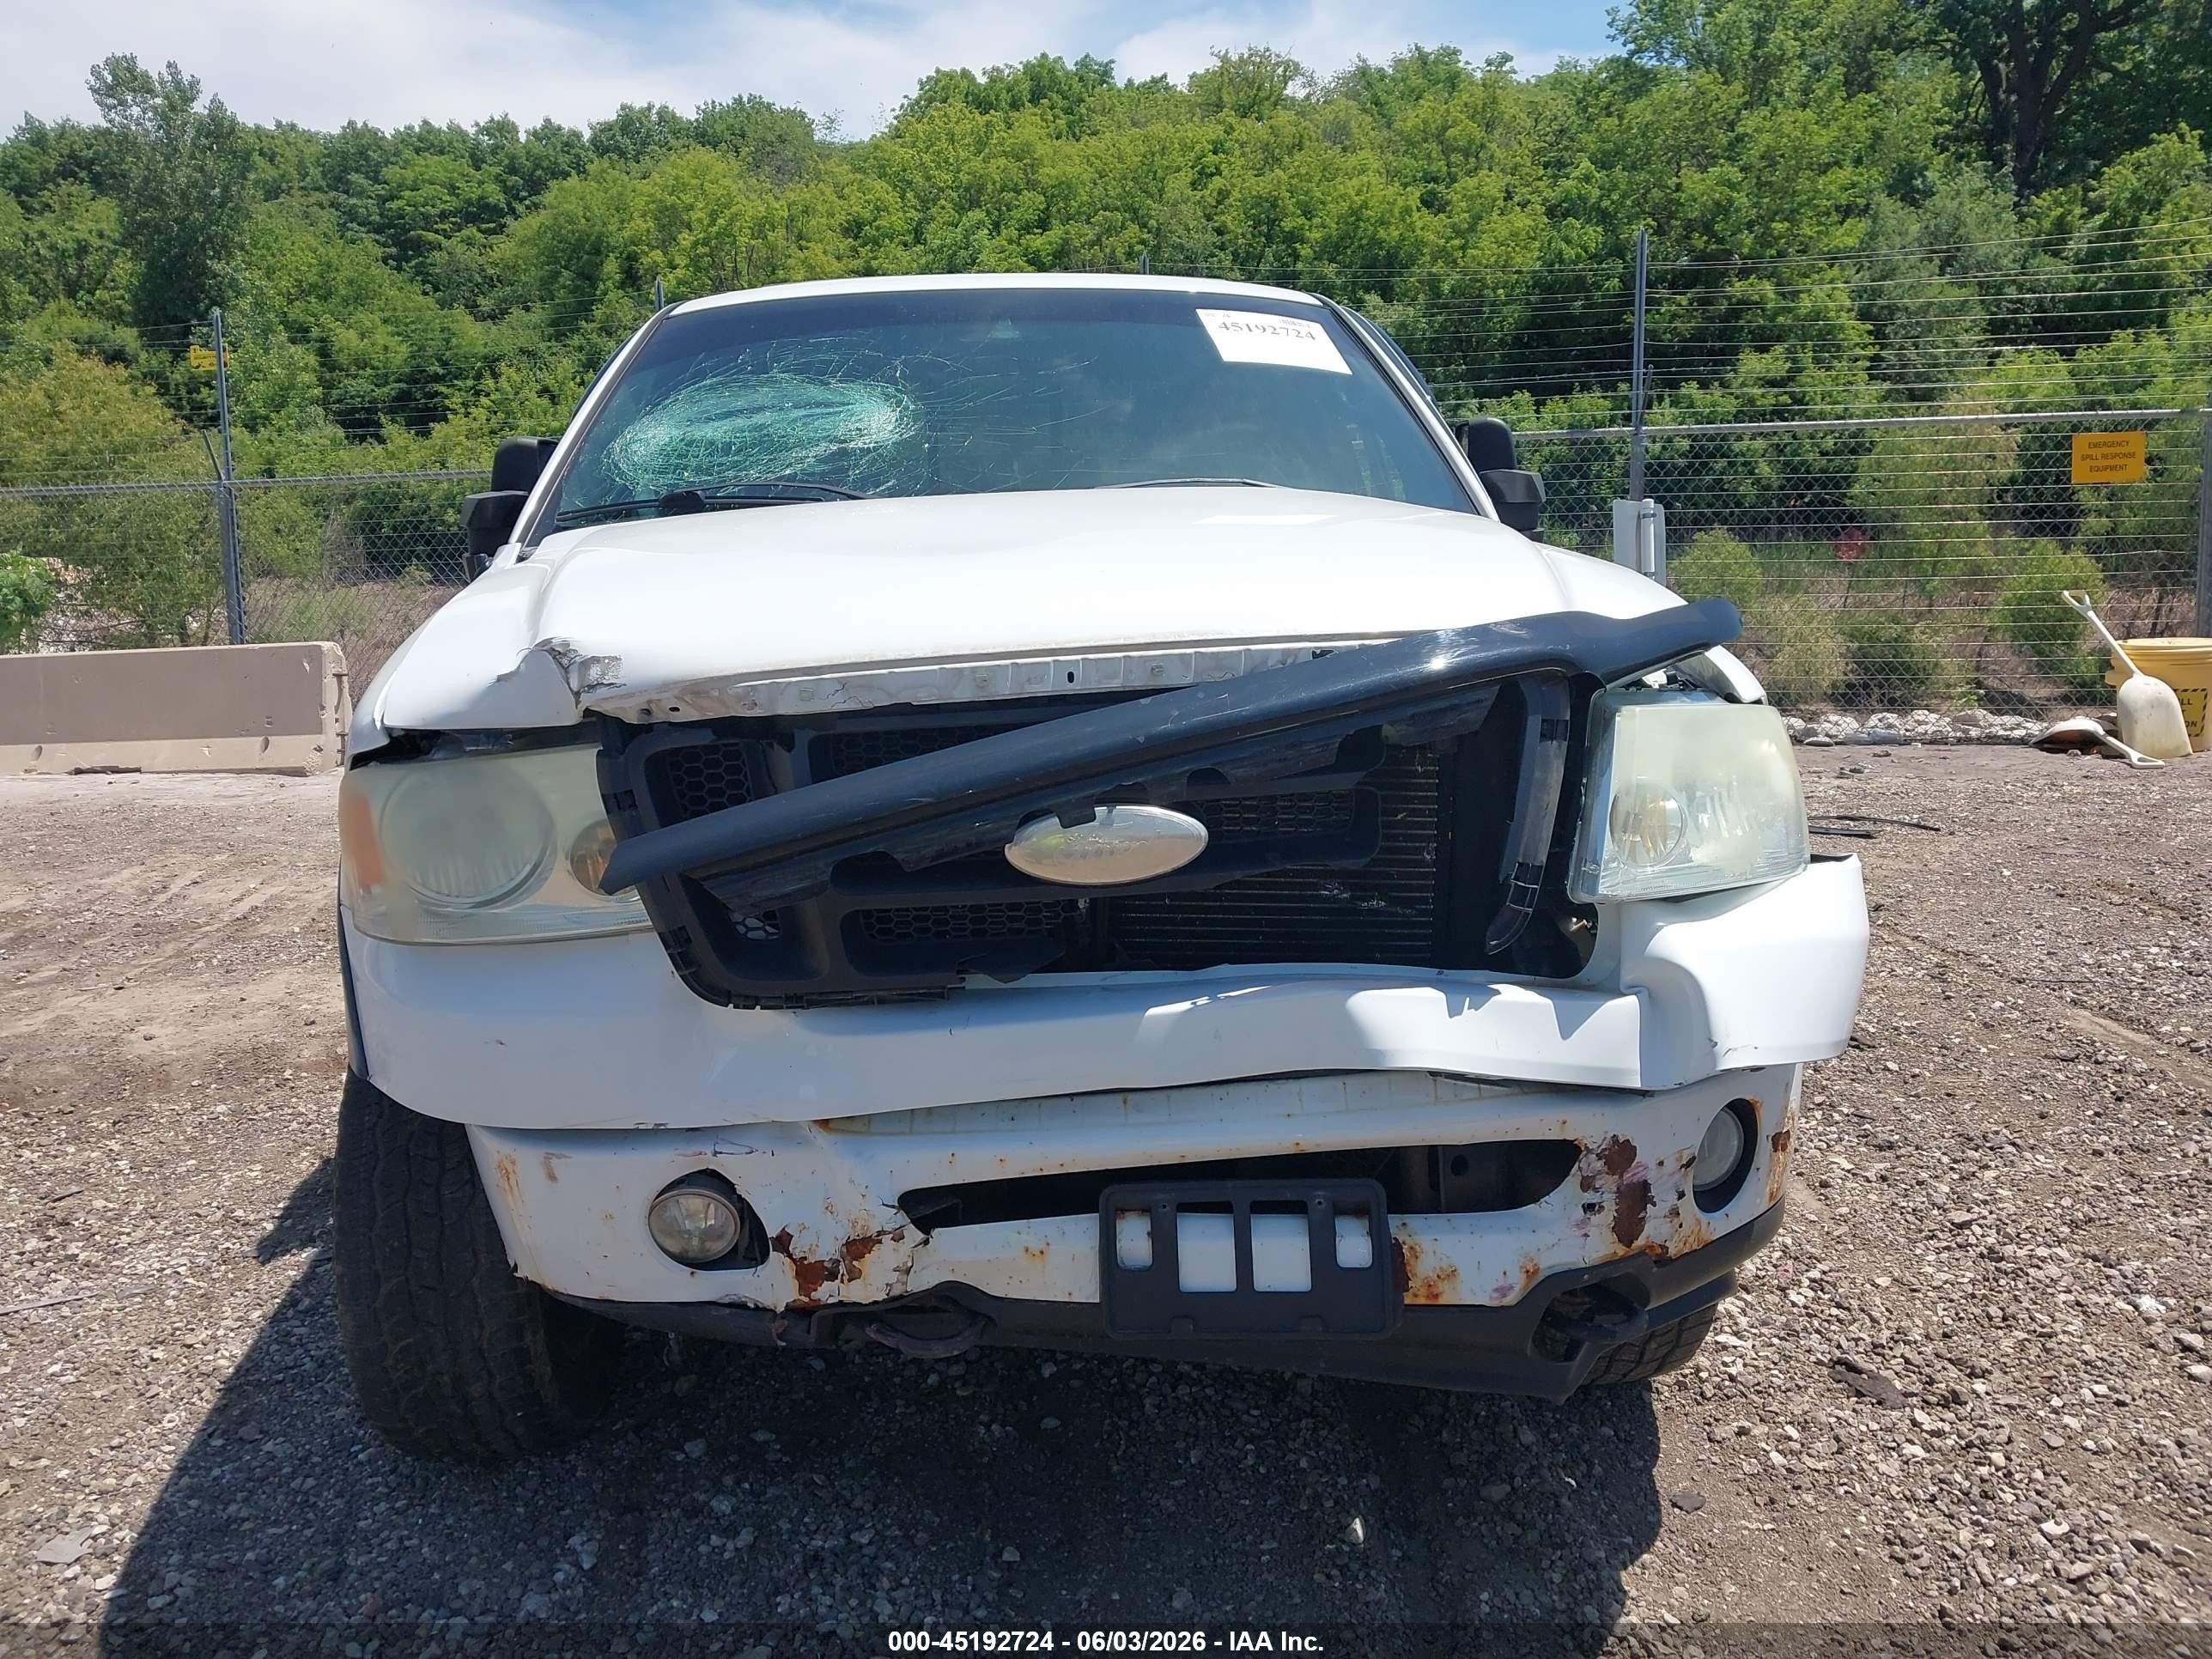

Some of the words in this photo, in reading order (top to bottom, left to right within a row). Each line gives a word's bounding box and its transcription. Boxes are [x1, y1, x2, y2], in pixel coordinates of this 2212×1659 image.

[1218, 321, 1316, 341] 45192724
[2087, 440, 2130, 448] EMERGENCY
[2081, 453, 2100, 461] SPILL
[2100, 452, 2136, 460] RESPONSE
[2089, 465, 2128, 473] EQUIPMENT
